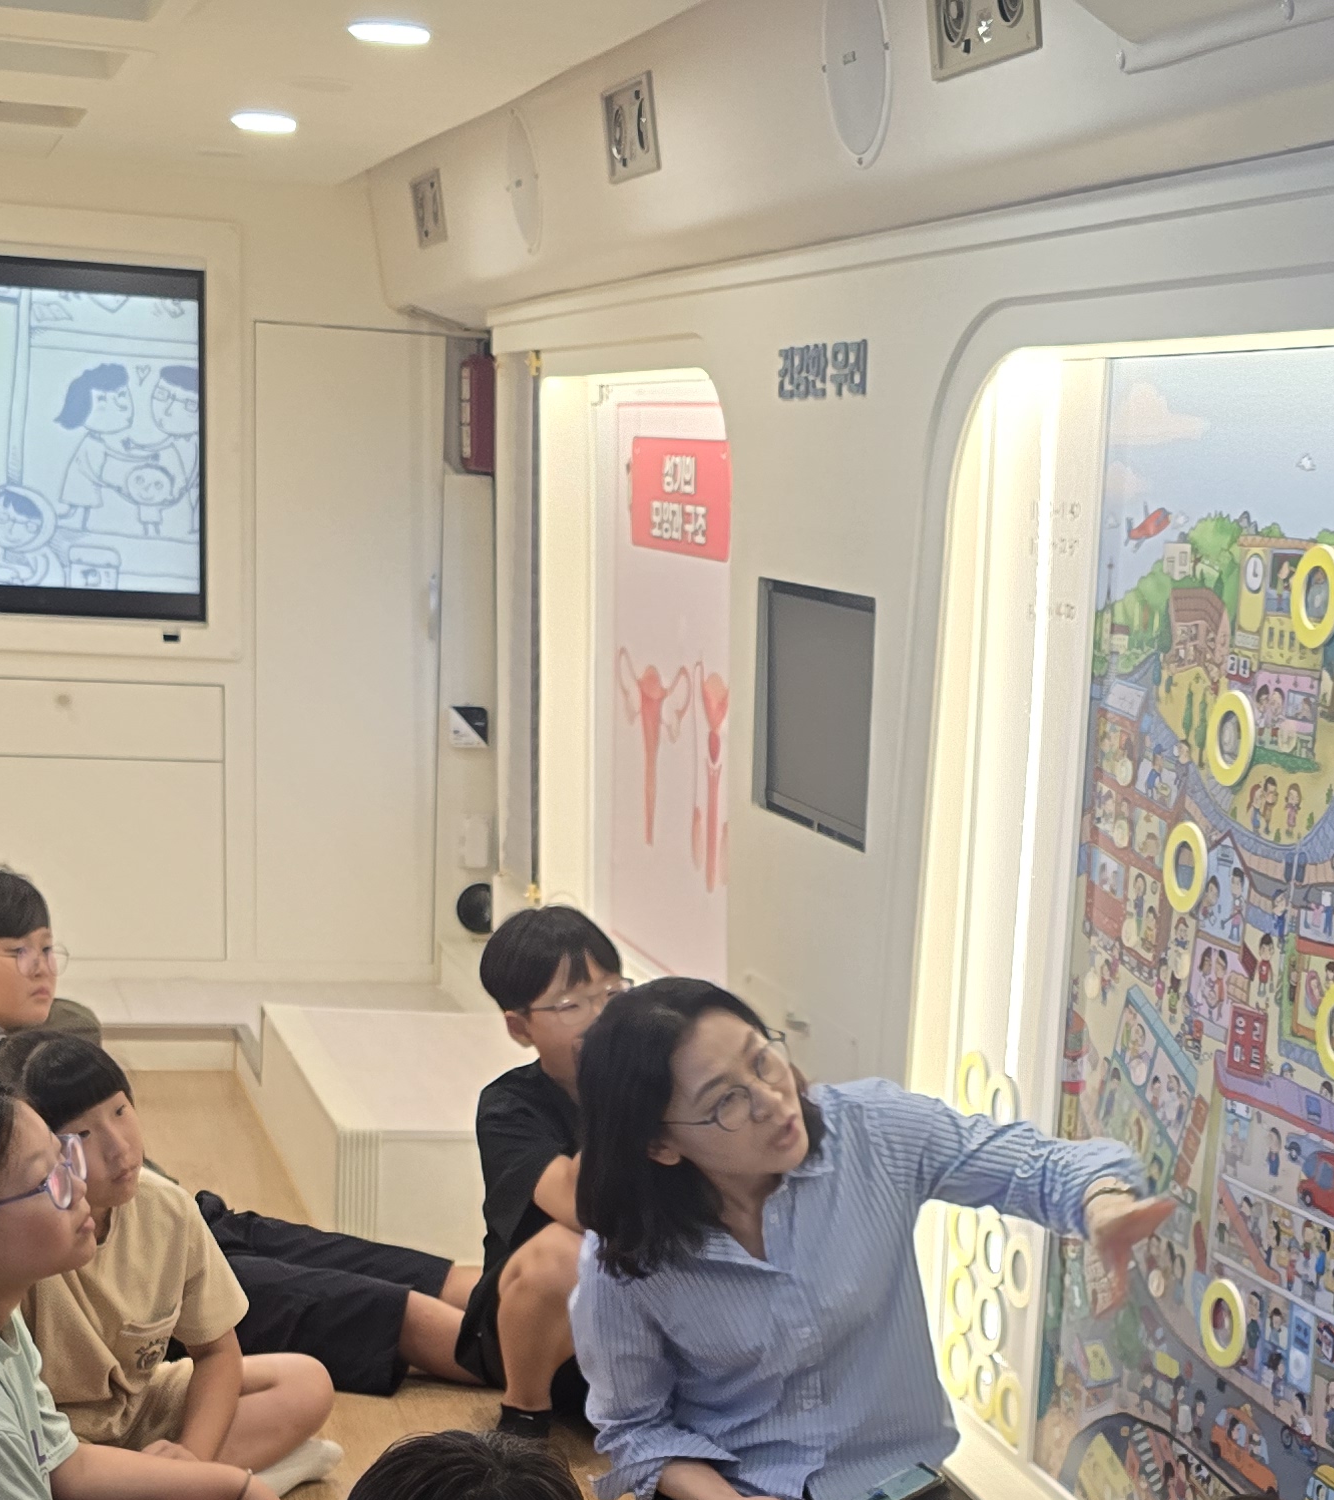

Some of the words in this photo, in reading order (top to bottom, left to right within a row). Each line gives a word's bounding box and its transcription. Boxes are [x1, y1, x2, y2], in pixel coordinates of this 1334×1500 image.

[778, 342, 827, 401] 건강한
[830, 339, 868, 397] 우리
[661, 454, 696, 495] 성기의
[650, 500, 684, 542] 모양과
[684, 504, 708, 545] 구조
